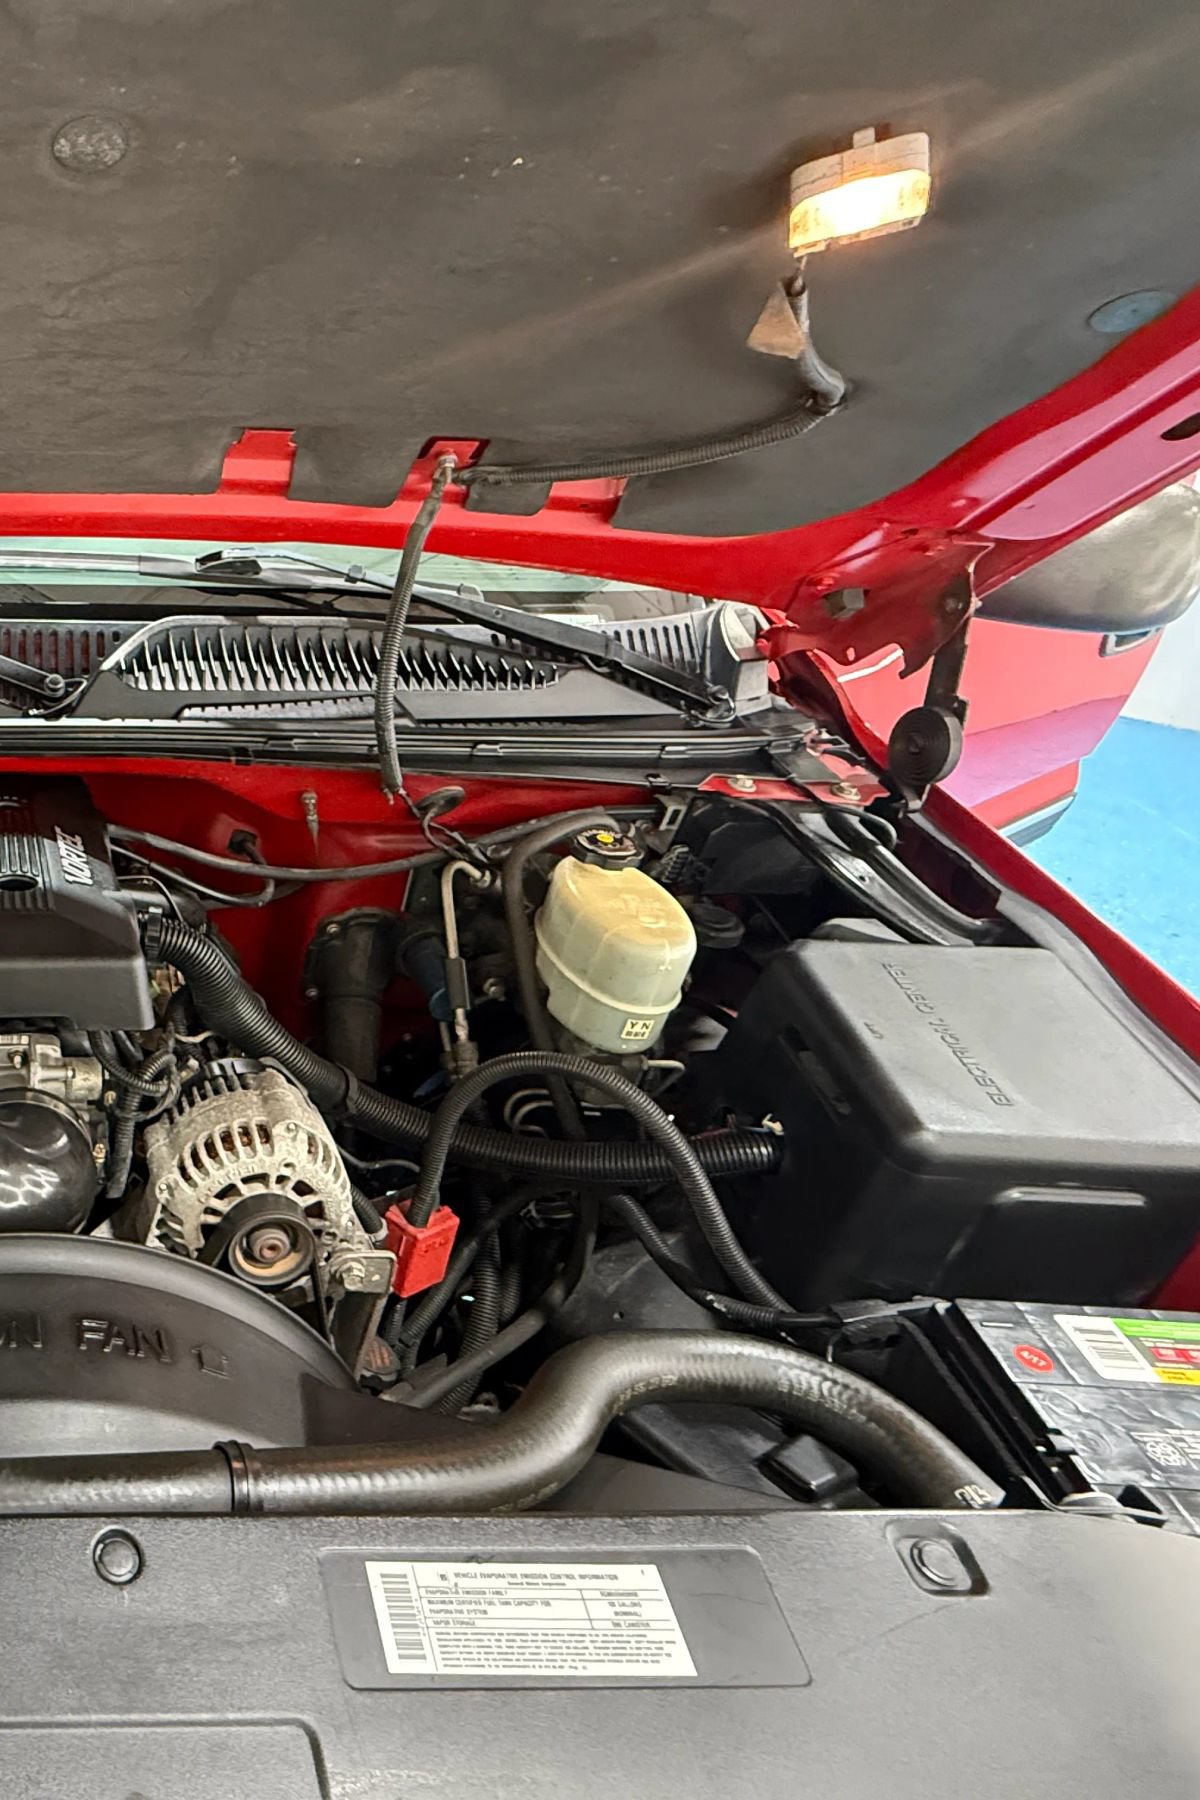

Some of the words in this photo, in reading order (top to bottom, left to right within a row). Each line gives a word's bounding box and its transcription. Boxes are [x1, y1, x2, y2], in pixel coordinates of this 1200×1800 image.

[54, 825, 94, 886] VORTEC
[881, 962, 936, 1015] CENTER
[928, 1017, 1015, 1107] ELECTRICAL
[77, 1317, 173, 1364] FAN
